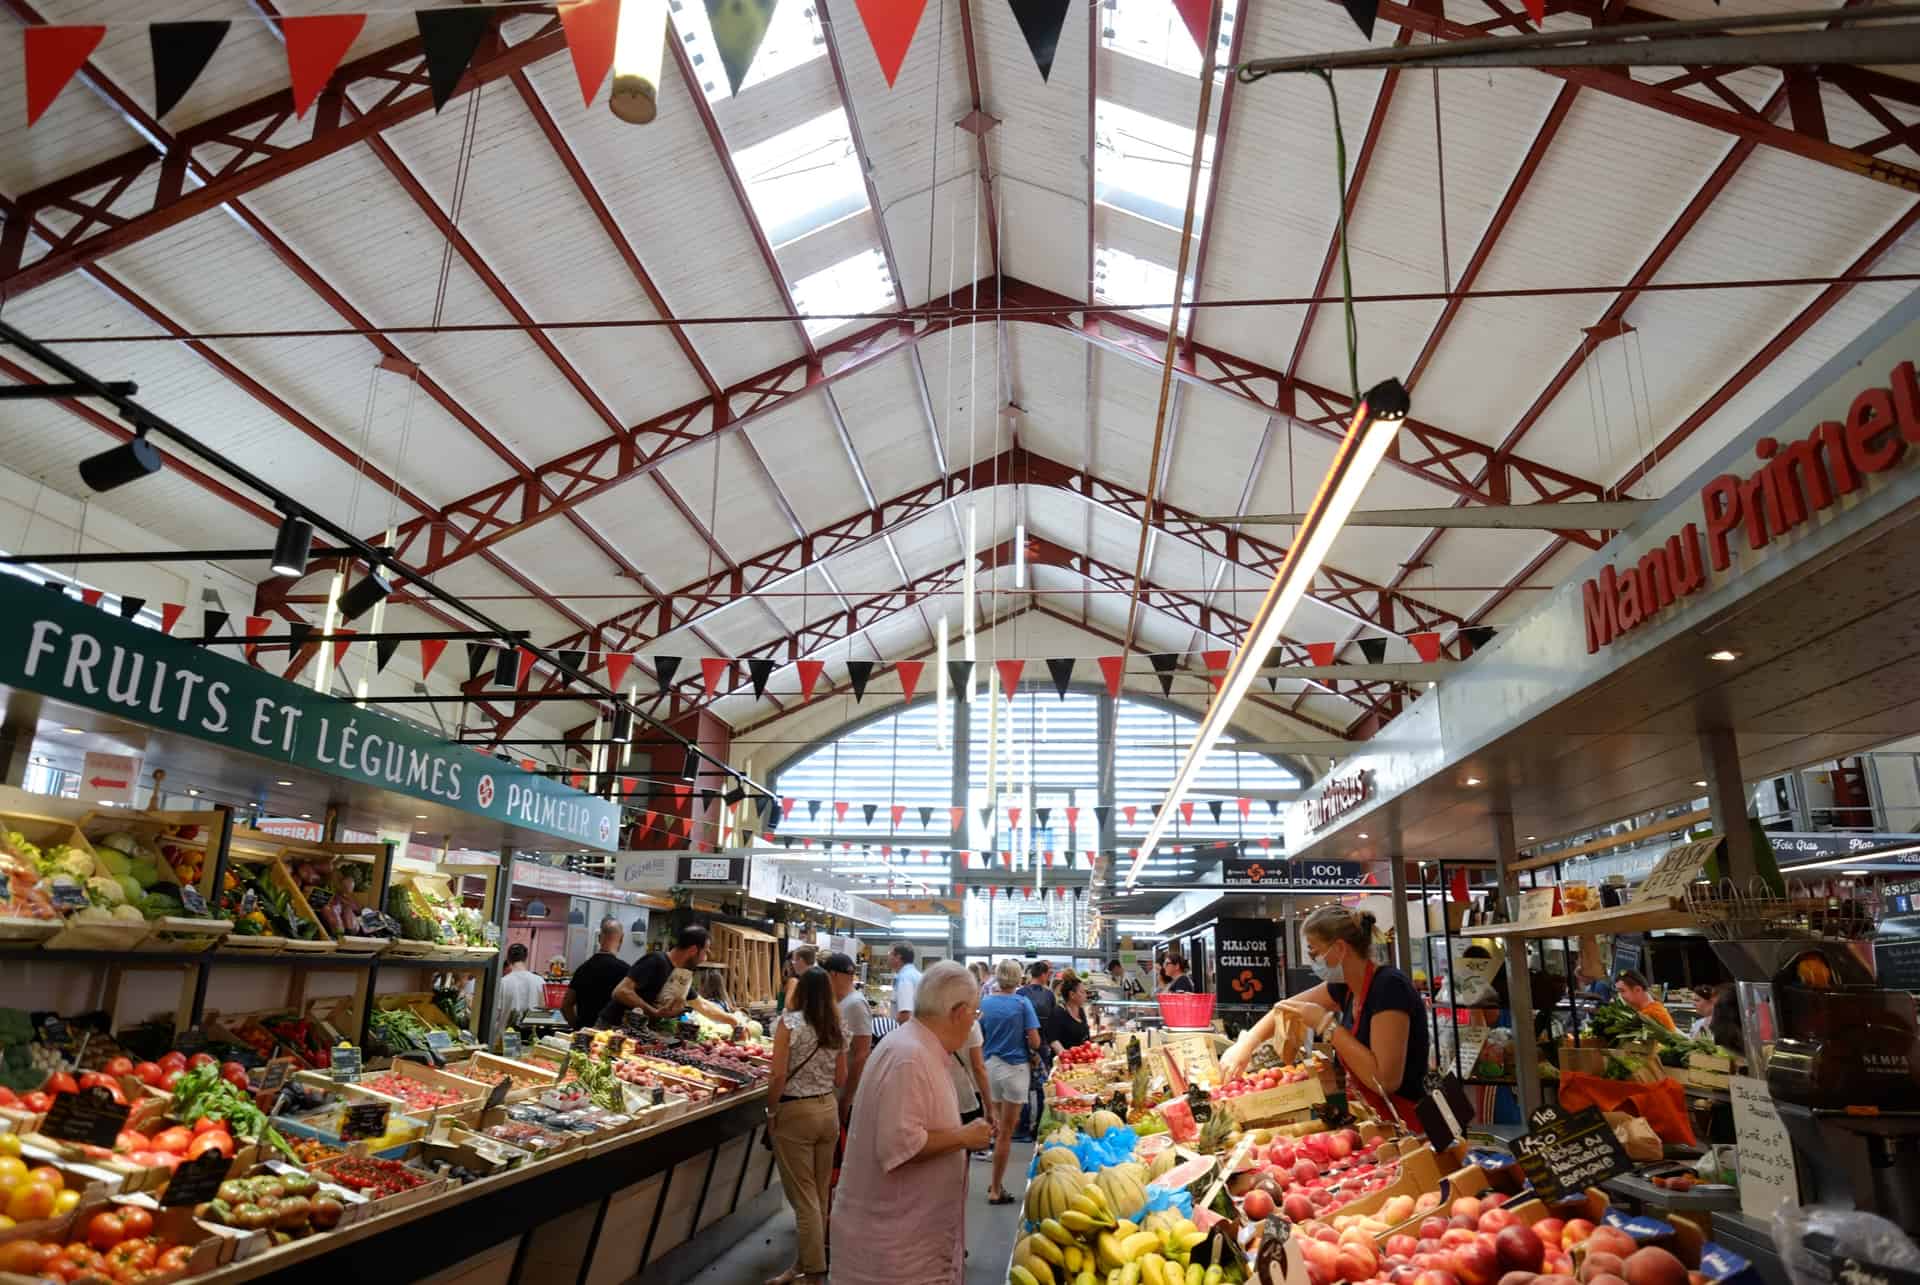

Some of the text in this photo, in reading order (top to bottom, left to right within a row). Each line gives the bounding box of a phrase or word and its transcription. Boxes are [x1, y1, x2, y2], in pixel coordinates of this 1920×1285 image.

[1582, 523, 1706, 655] Manu
[23, 619, 591, 837] FRUITS ET LÉGUMES PRIMEUR
[1771, 838, 1819, 852] Foie Gras
[1311, 864, 1342, 876] 1001
[1293, 878, 1362, 886] FROMAGES
[1222, 940, 1268, 951] MAISON
[1220, 956, 1271, 967] CHAILLA
[1533, 1108, 1557, 1126] 1kg
